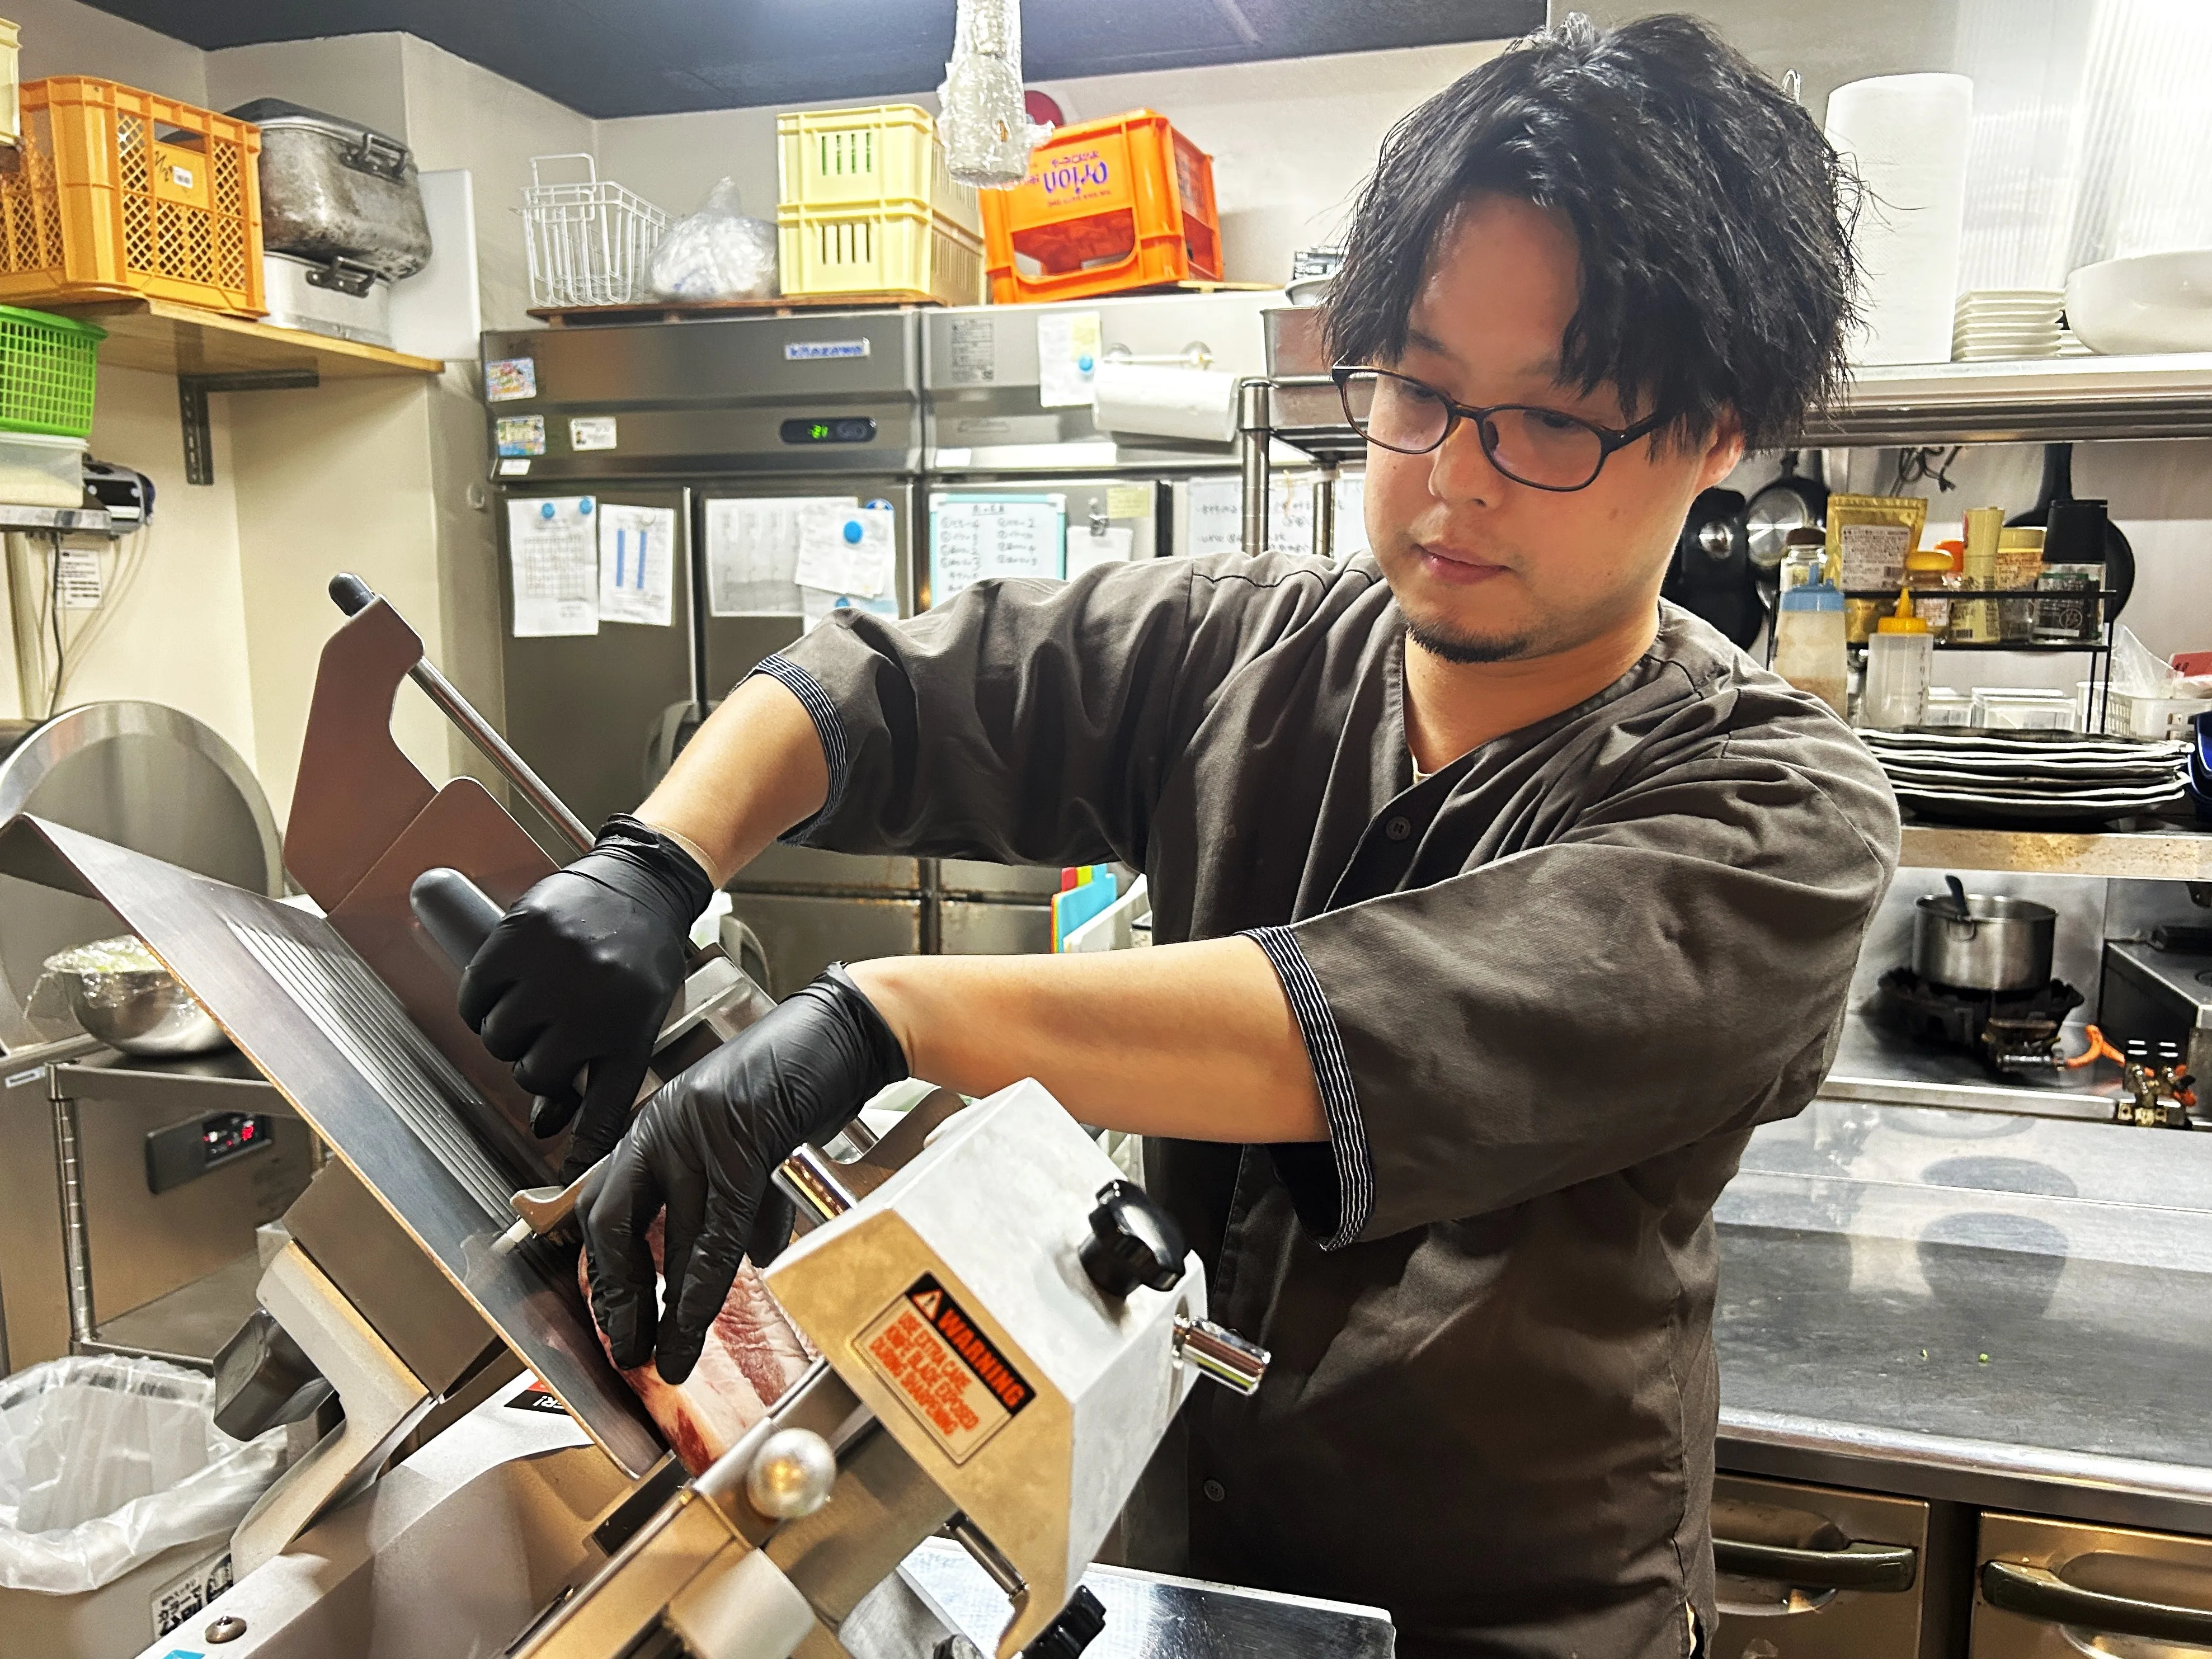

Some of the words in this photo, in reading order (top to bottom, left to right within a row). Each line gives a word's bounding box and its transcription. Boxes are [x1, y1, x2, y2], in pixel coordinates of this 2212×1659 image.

[1043, 162, 1107, 193] Orion
[897, 1311, 922, 1335] USE
[914, 1330, 949, 1366] EXTRA
[934, 1308, 1027, 1408] WARNING
[869, 1337, 907, 1378] DURING
[899, 1373, 958, 1435] SHARPENING
[907, 1351, 941, 1387] BLADE
[933, 1382, 980, 1431] EXPOSED
